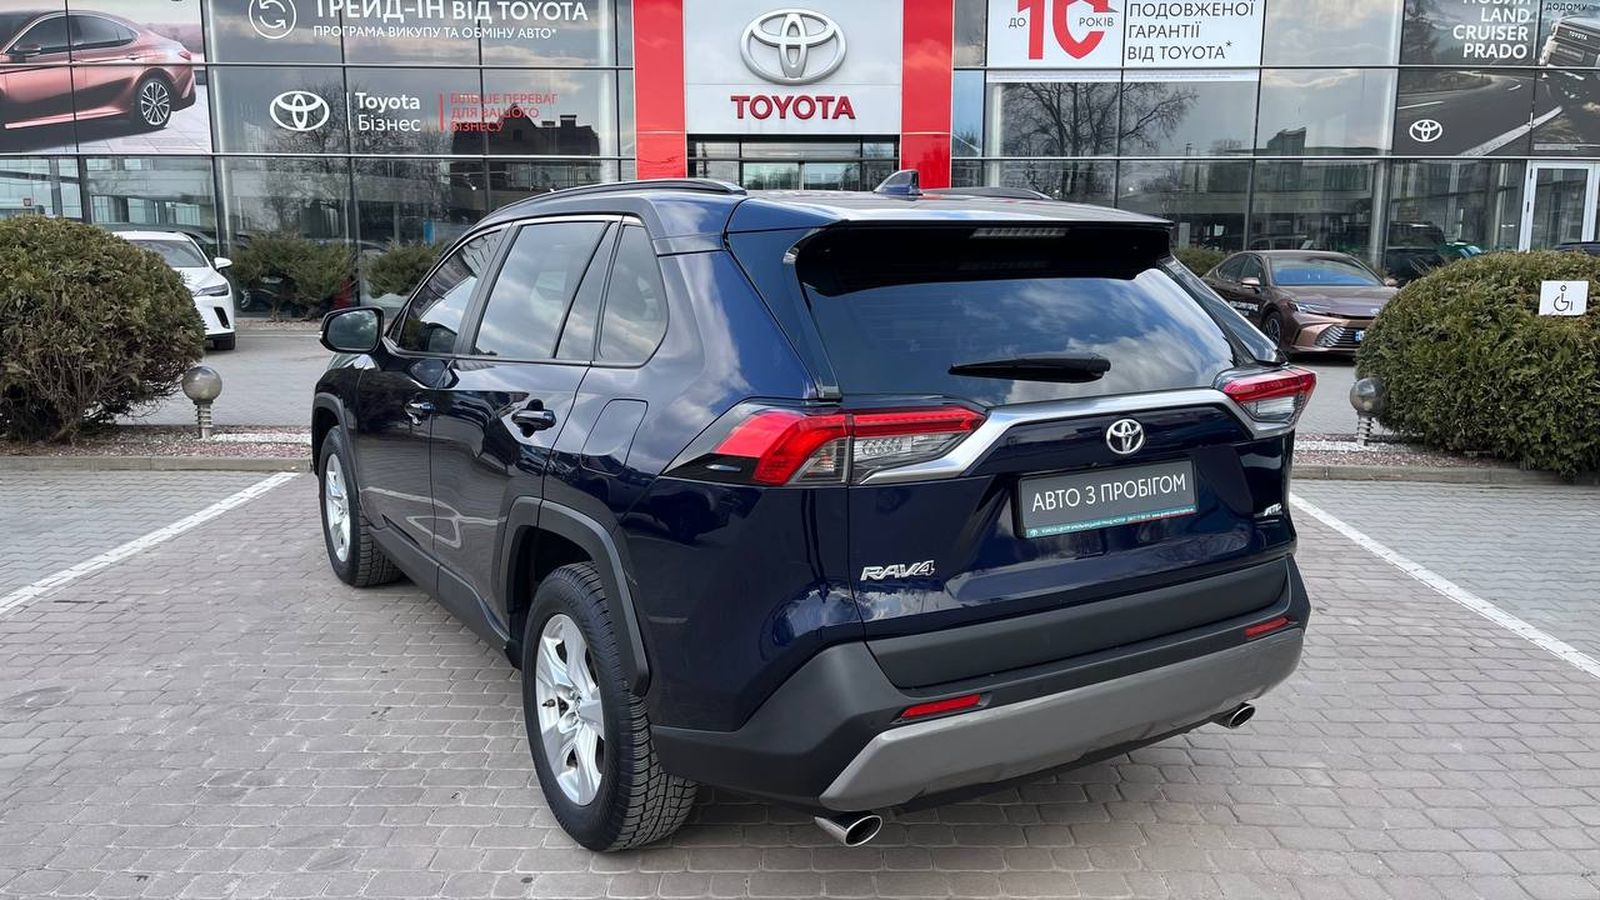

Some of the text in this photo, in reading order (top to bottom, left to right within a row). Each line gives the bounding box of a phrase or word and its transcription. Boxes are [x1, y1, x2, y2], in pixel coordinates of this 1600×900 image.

[452, 2, 492, 24] ВІД
[497, 2, 588, 21] TOYOTA
[1129, 0, 1256, 20] ПОДОВЖЕНОЇ
[1545, 2, 1588, 11] ДОДОМУ
[1008, 17, 1027, 28] ДО
[1079, 17, 1115, 27] РОКІВ
[1481, 7, 1531, 23] LAND
[313, 25, 385, 37] ПРОГРАМА
[388, 26, 440, 38] ВИКУПУ
[444, 27, 460, 38] ТА
[462, 27, 515, 39] ОБМІНУ
[1128, 20, 1202, 38] ГАРАНТІЇ
[1453, 25, 1529, 41] CRUISER
[1127, 45, 1155, 62] ВІД
[1463, 43, 1528, 59] PRADO
[355, 91, 421, 114] Toyota
[504, 93, 558, 104] ПЕРЕВАГ
[452, 107, 478, 119] ДЛЯ
[731, 95, 856, 120] TOYOTA
[358, 114, 421, 132] Бізнес
[450, 121, 505, 132] БІЗНЕСУ
[1032, 488, 1081, 512] АВТО
[1101, 473, 1186, 502] ПРОБІГОМ
[860, 560, 935, 581] RAV4
